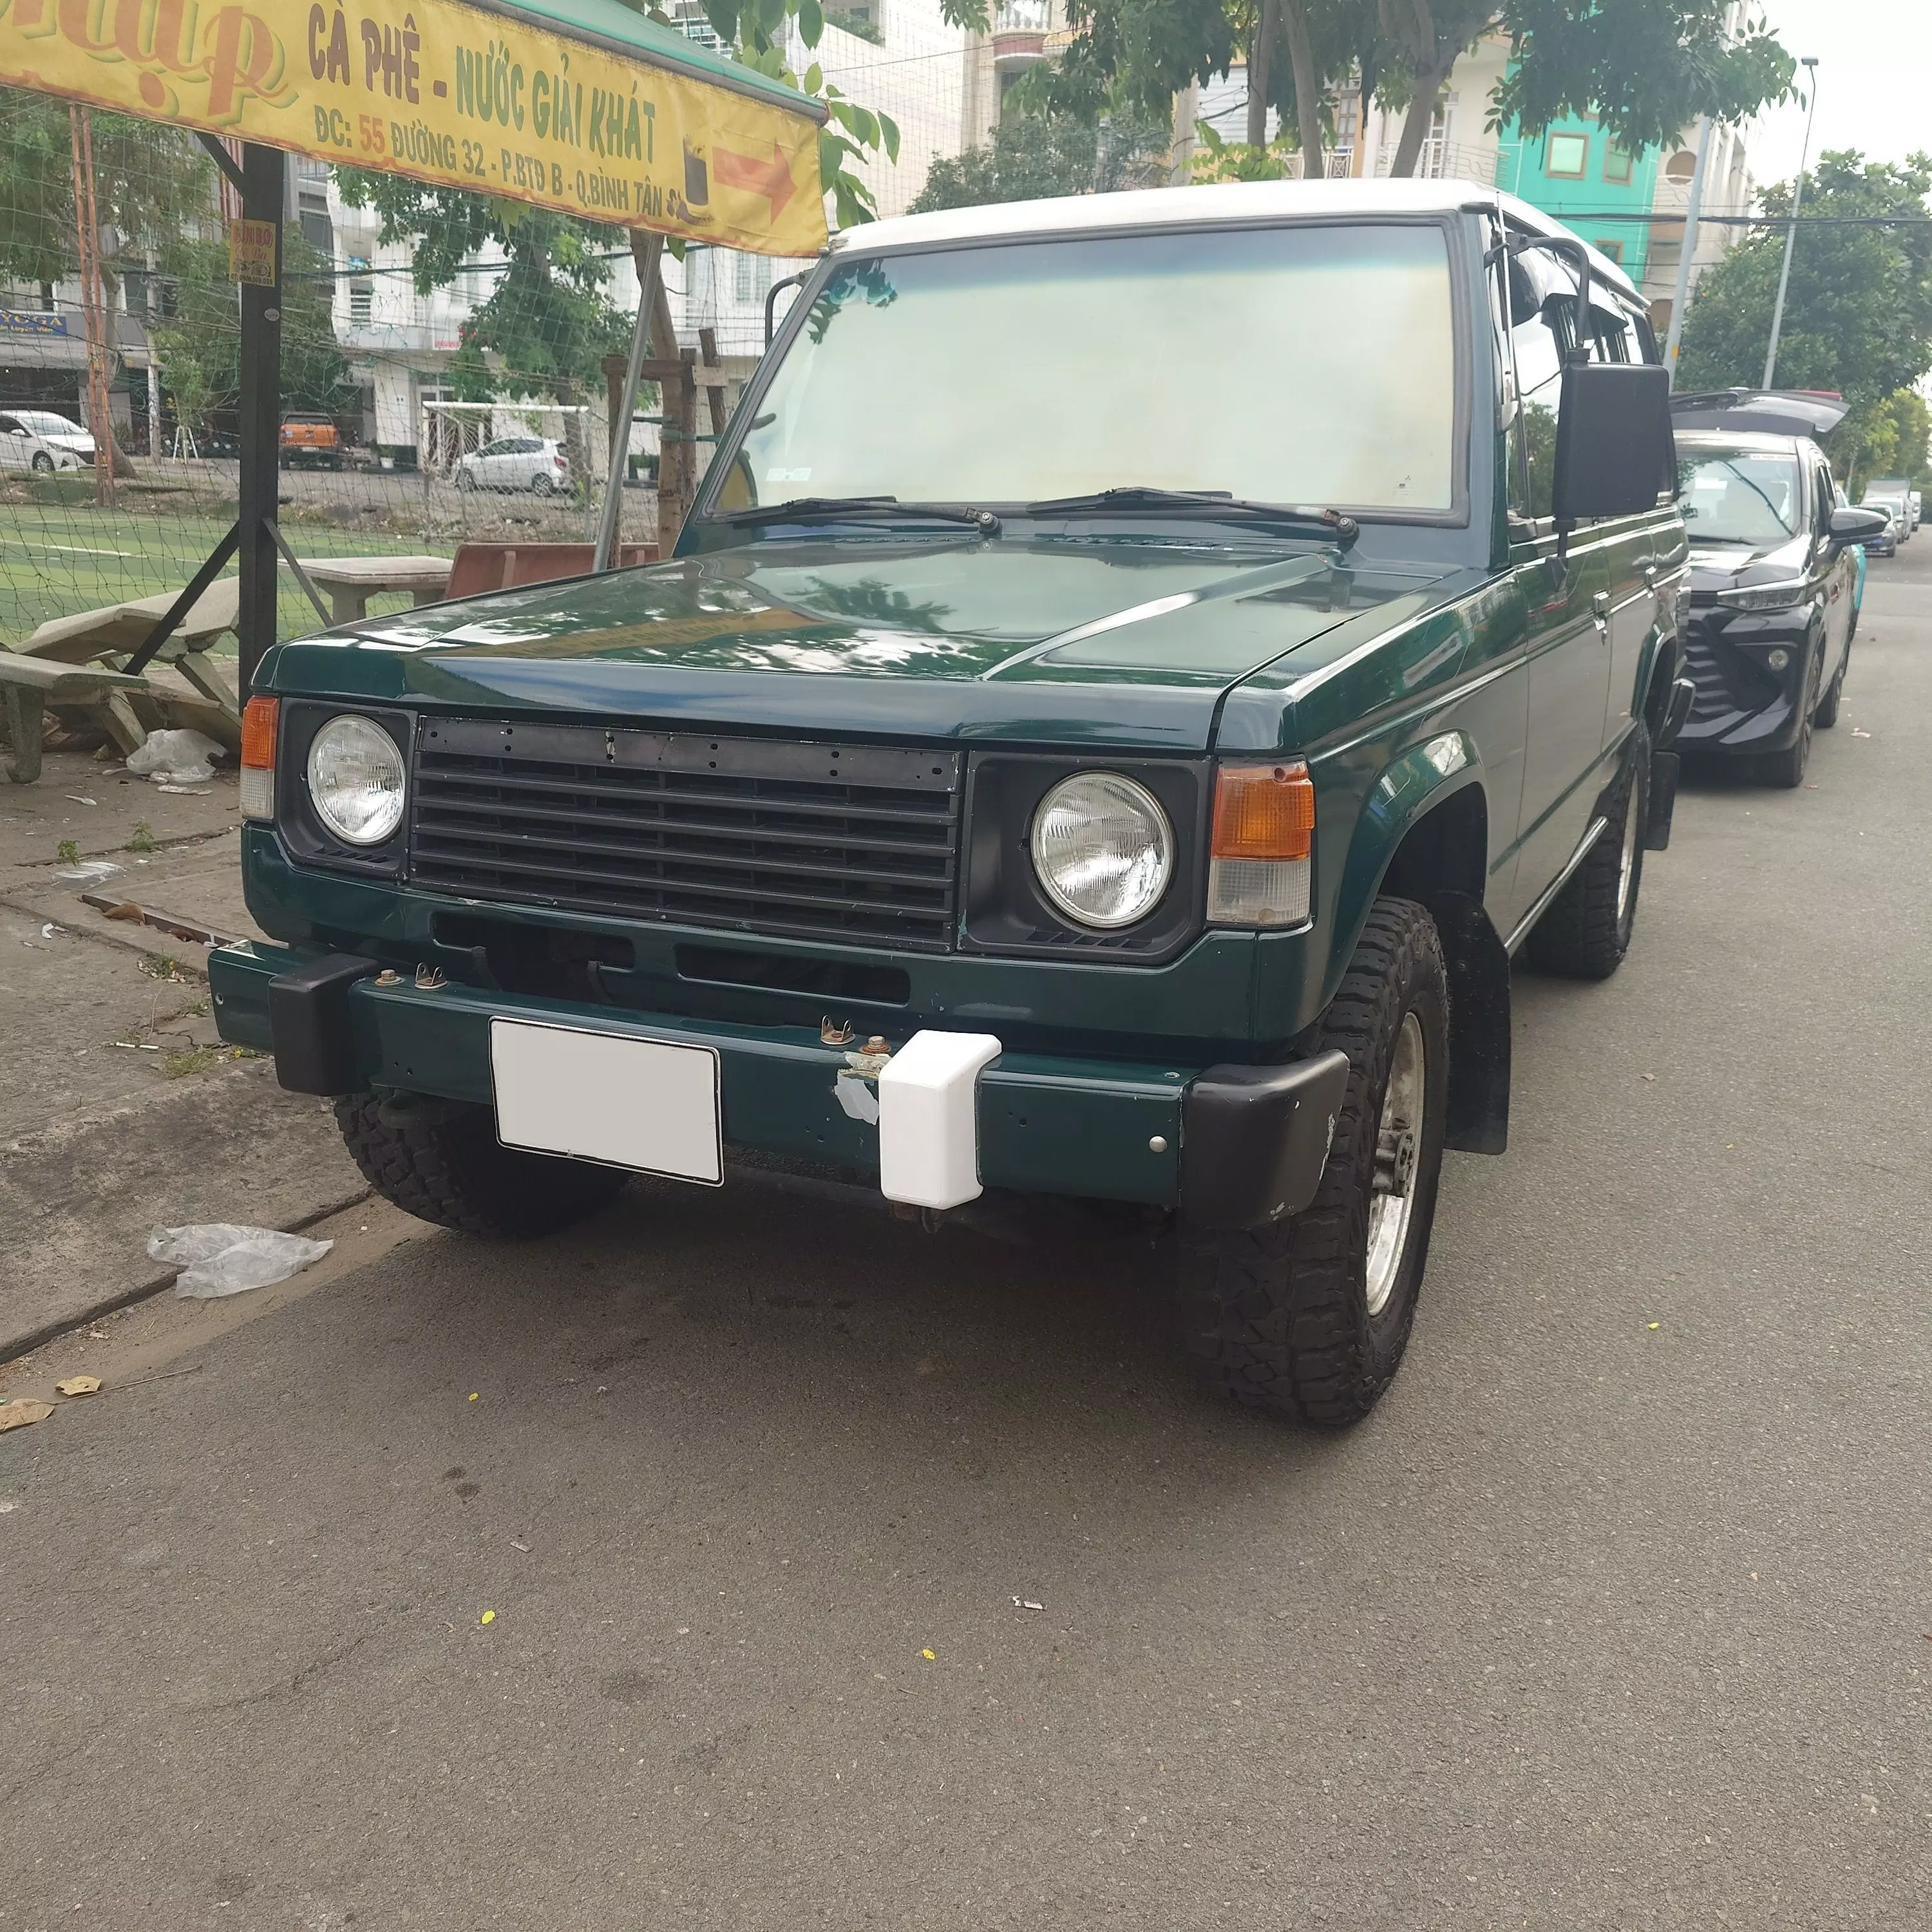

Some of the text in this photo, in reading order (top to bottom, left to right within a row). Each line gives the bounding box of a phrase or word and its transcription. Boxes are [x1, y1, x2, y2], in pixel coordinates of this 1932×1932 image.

[308, 0, 656, 164] CÀ PHÊ - NƯỚC GIẢI KHÁT
[314, 104, 352, 148] ĐC:
[359, 114, 386, 154] 55
[390, 118, 457, 171] ĐƯỜNG
[462, 138, 486, 176] 32
[501, 148, 545, 191] P.BTĐ
[551, 162, 563, 196] B
[576, 166, 629, 211] Q.BÌNH
[633, 175, 663, 218] TÂN
